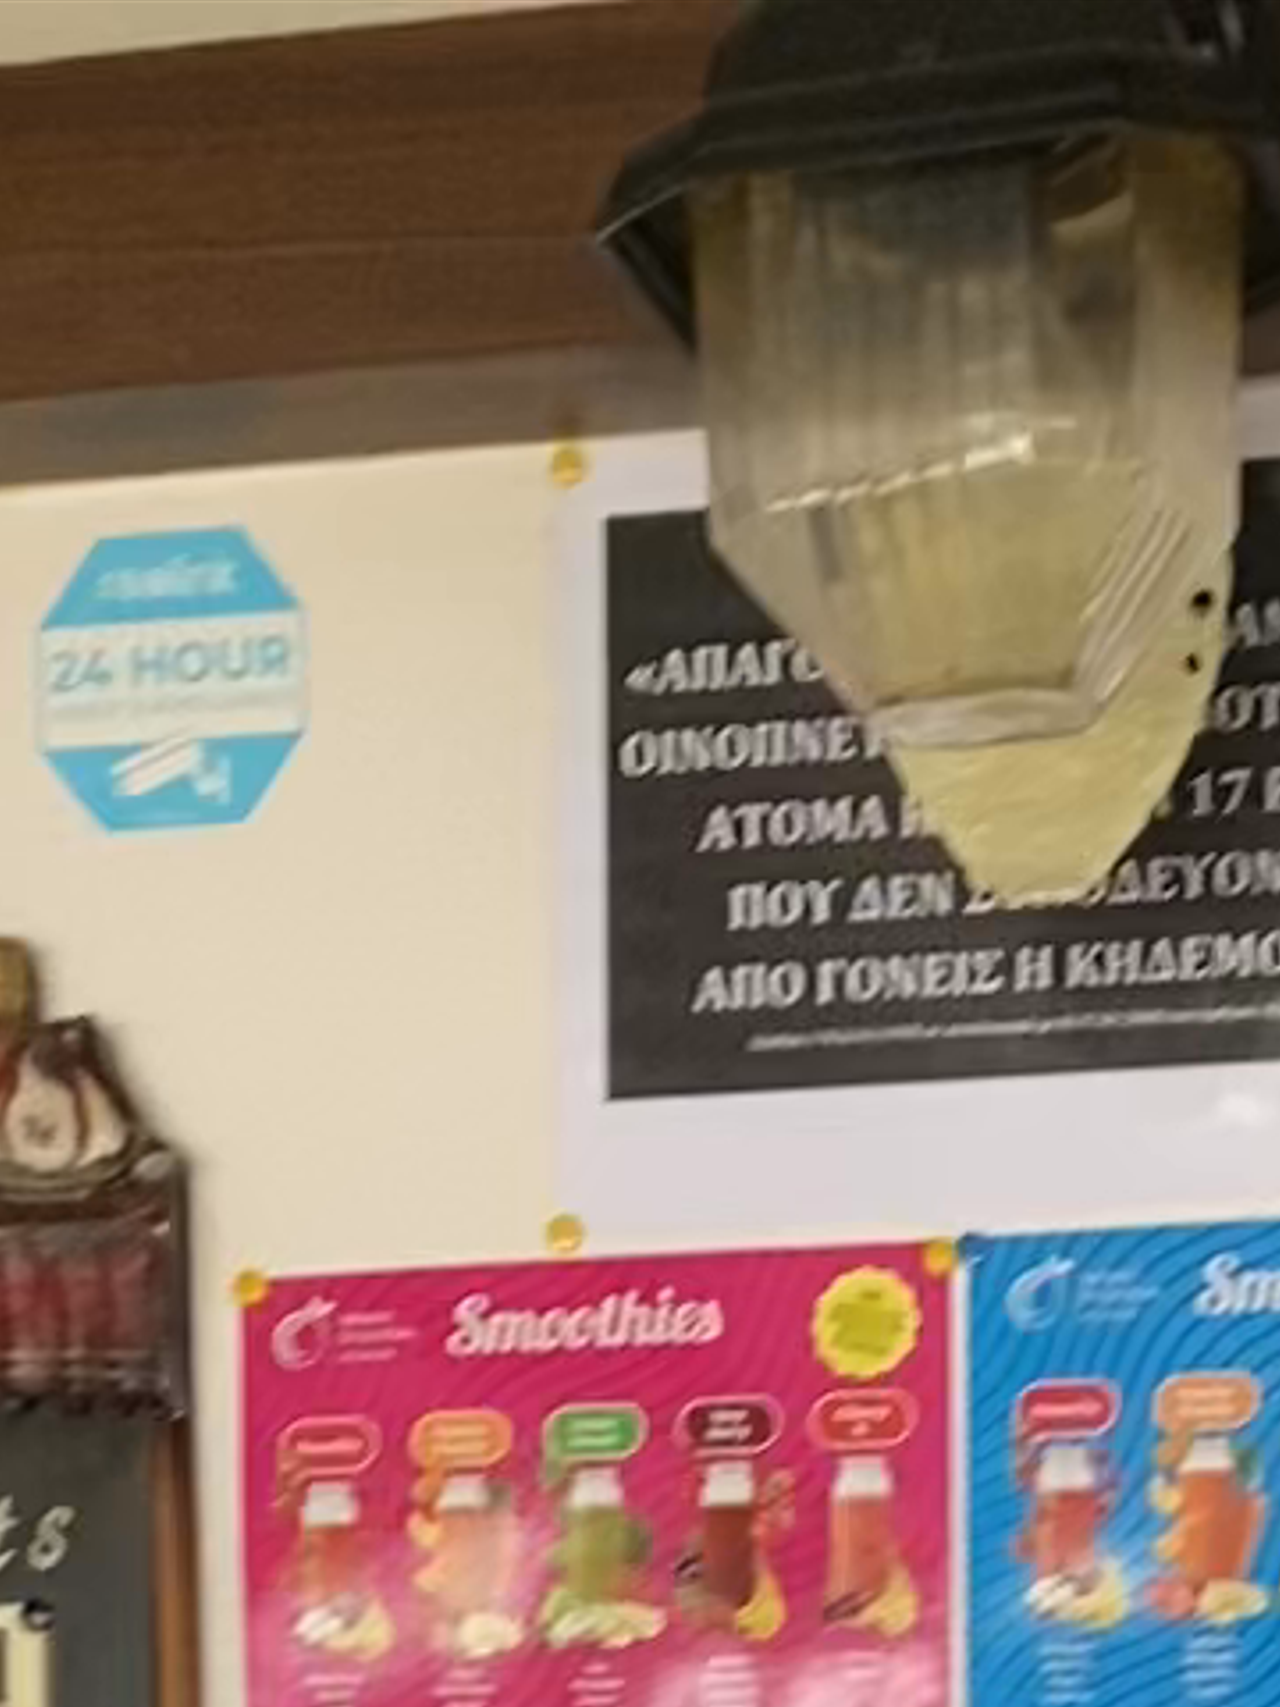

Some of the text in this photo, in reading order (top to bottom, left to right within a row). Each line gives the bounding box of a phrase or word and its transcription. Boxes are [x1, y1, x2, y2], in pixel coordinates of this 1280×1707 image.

[50, 635, 290, 694] 24 HOUR
[696, 795, 889, 853] ΑΤΟΜΑ
[1186, 767, 1253, 817] 17
[727, 877, 843, 932] ΠΟΥ
[846, 870, 954, 923] ΔΕΝ
[691, 960, 806, 1014] ΑΠΟ
[814, 947, 1006, 1006] ΓΟΝΕΙΣ
[1013, 945, 1055, 993] Η
[445, 1286, 724, 1355] Smoothies
